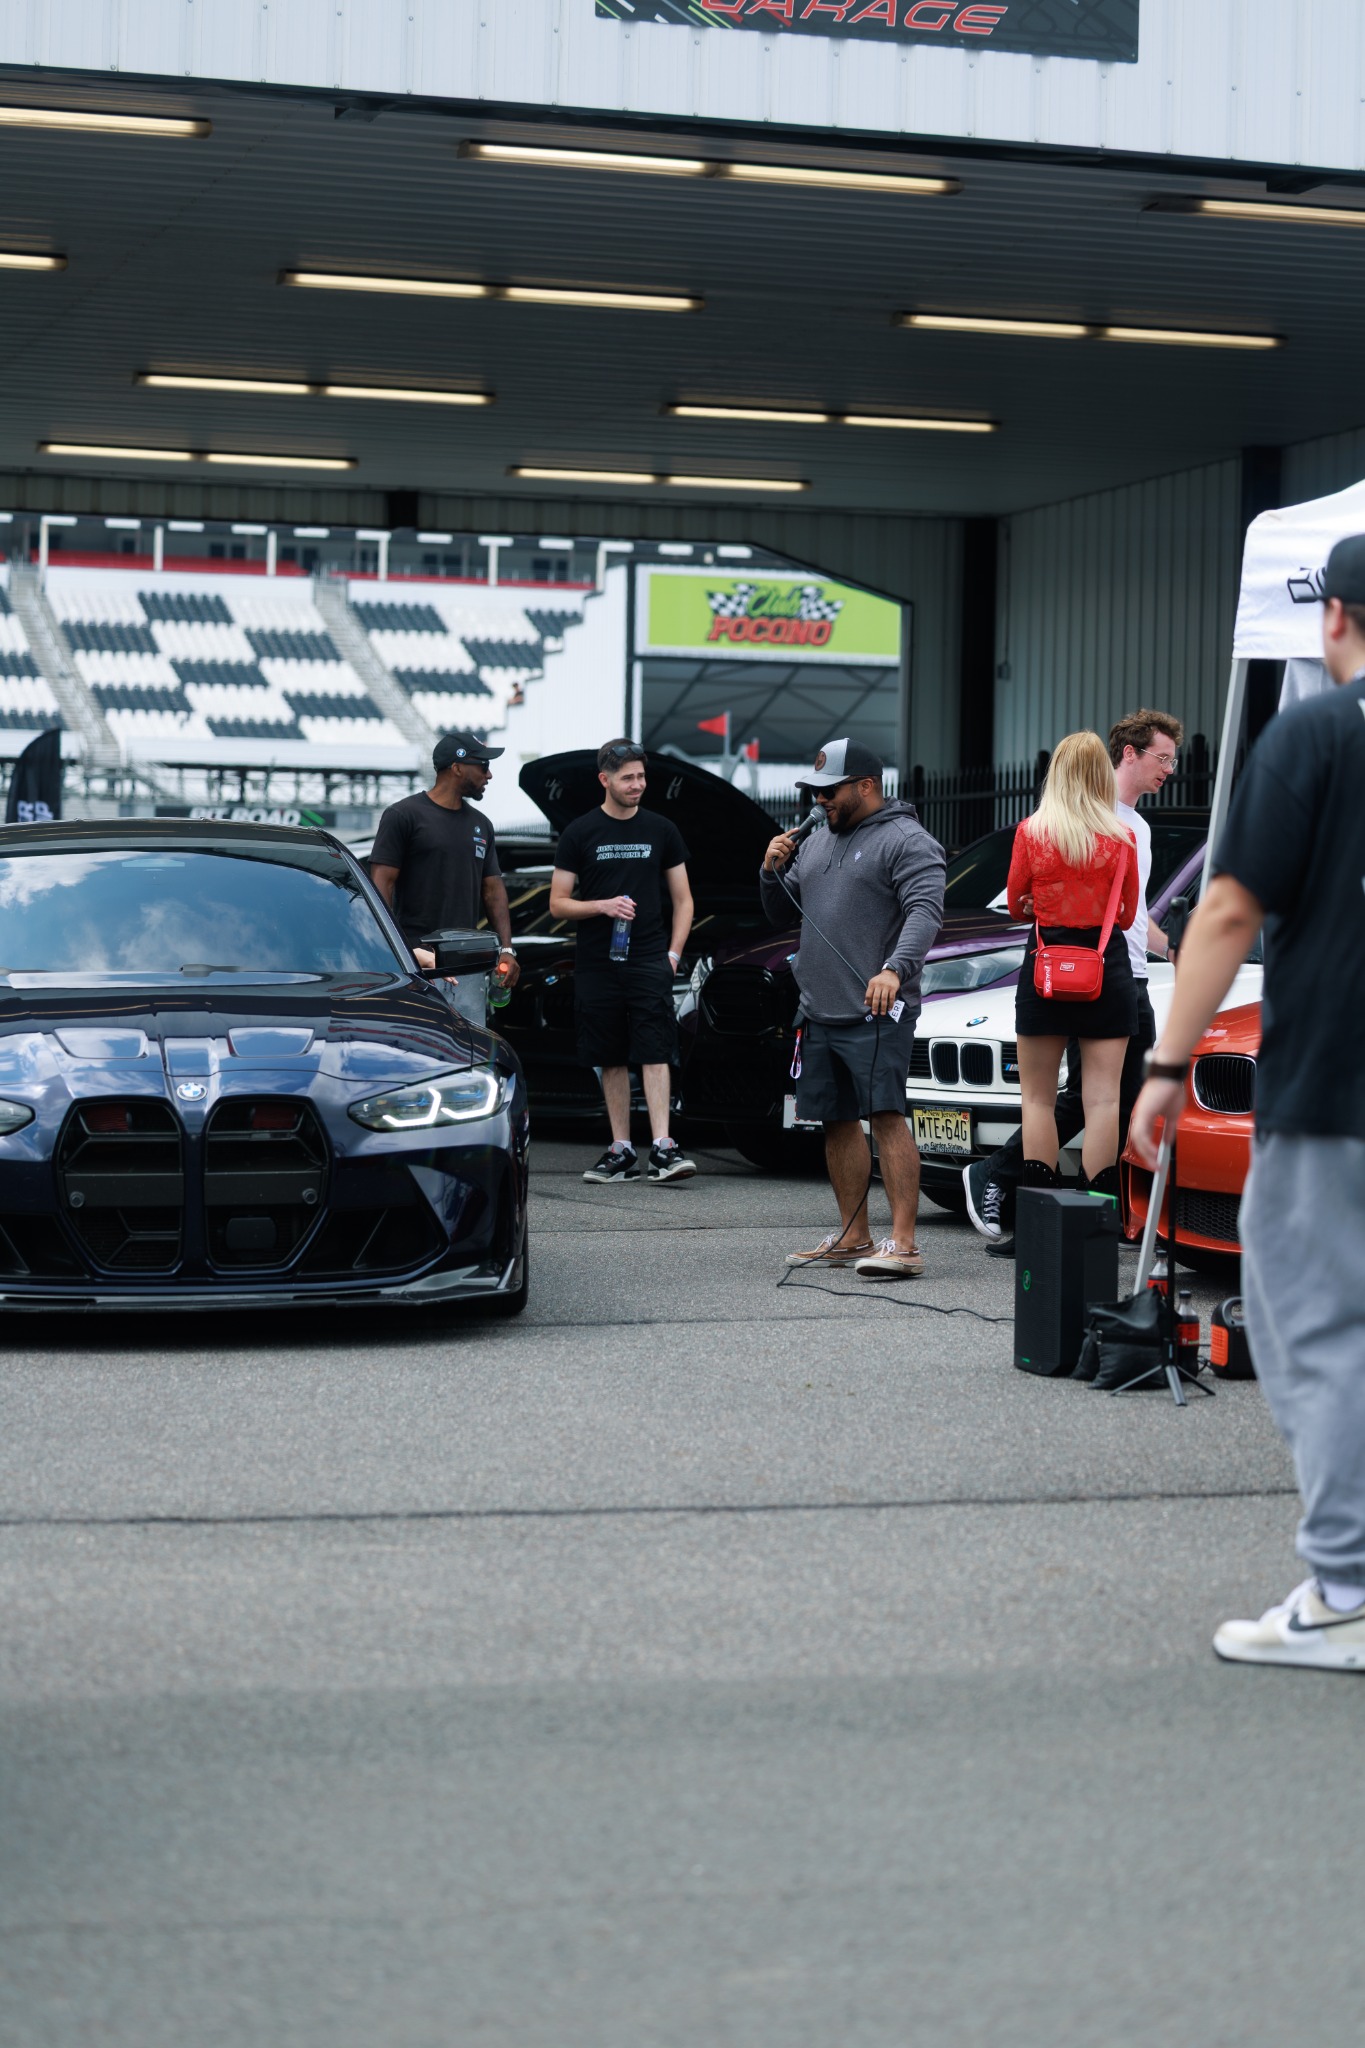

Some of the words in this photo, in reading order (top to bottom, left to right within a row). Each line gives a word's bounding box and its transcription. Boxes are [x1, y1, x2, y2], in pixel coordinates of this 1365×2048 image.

[707, 616, 832, 646] POCONO
[230, 808, 300, 826] ROAD
[597, 852, 614, 860] AND
